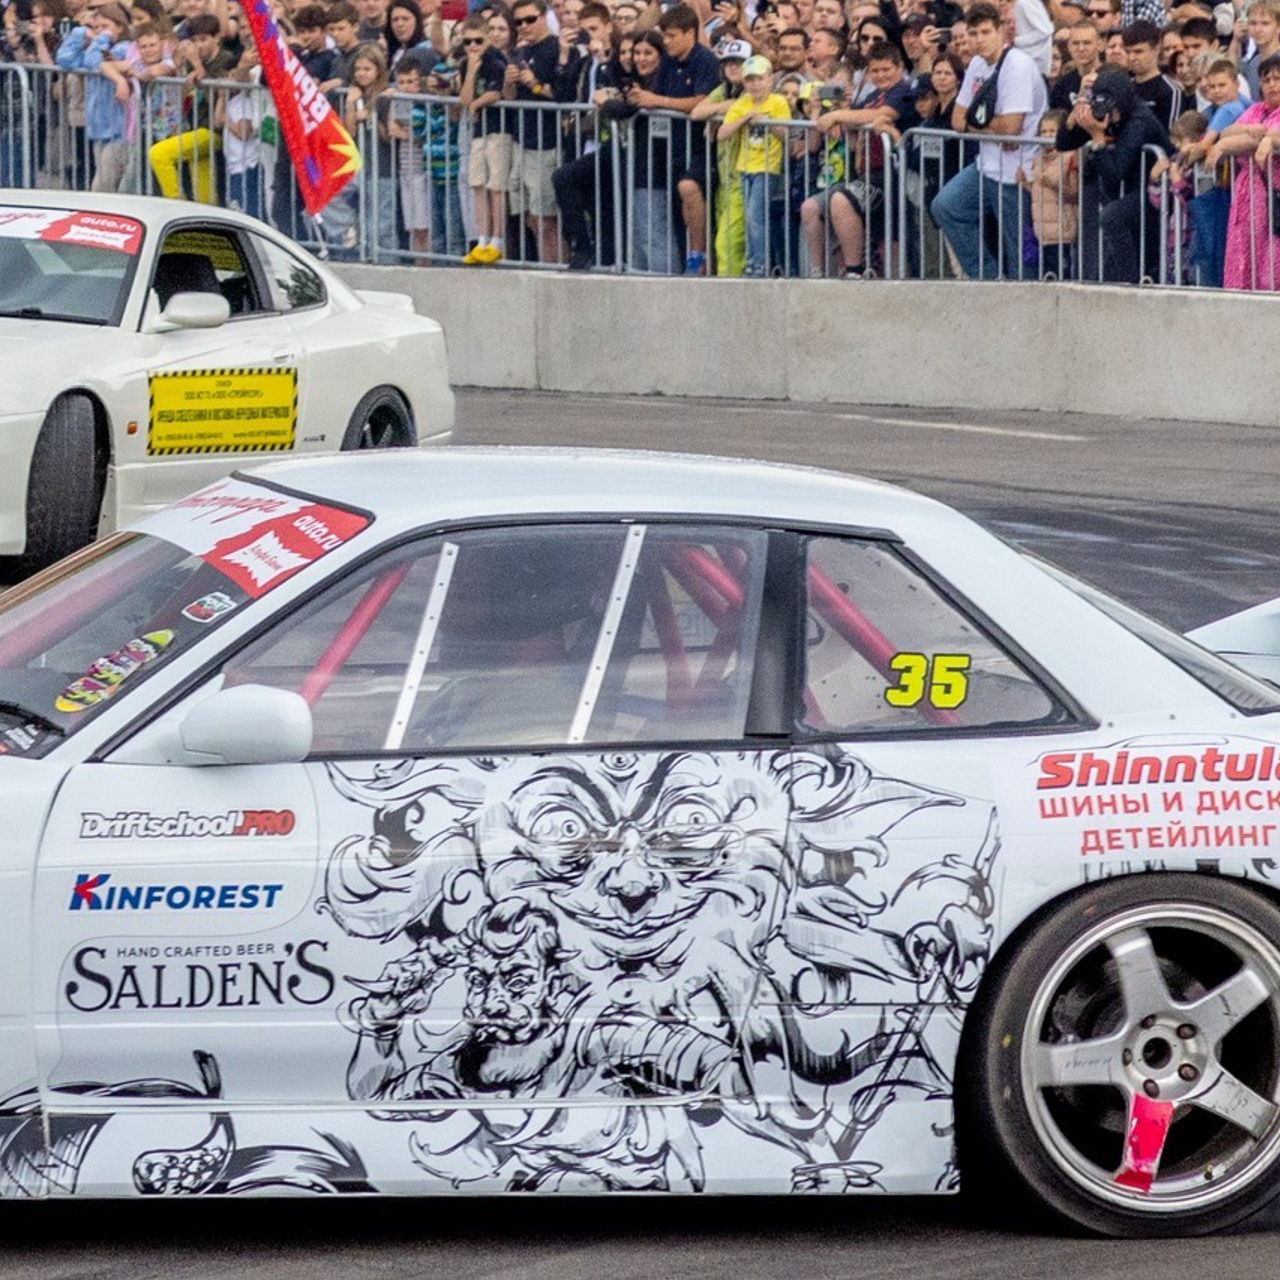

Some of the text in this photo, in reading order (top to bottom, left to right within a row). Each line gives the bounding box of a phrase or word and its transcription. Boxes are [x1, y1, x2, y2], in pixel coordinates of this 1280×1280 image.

[80, 216, 138, 232] auto.ru
[292, 515, 342, 551] auto.ru
[884, 652, 971, 710] 35
[1036, 746, 1280, 790] Shinntul
[1038, 792, 1150, 819] ШИНЫ
[1162, 791, 1183, 813] И
[1081, 820, 1277, 856] ДЕТЕЙЛИНГ
[69, 873, 284, 911] KINFOREST
[117, 943, 276, 958] HAND CRAFTED BEER
[65, 939, 336, 1012] SALDEN'S
